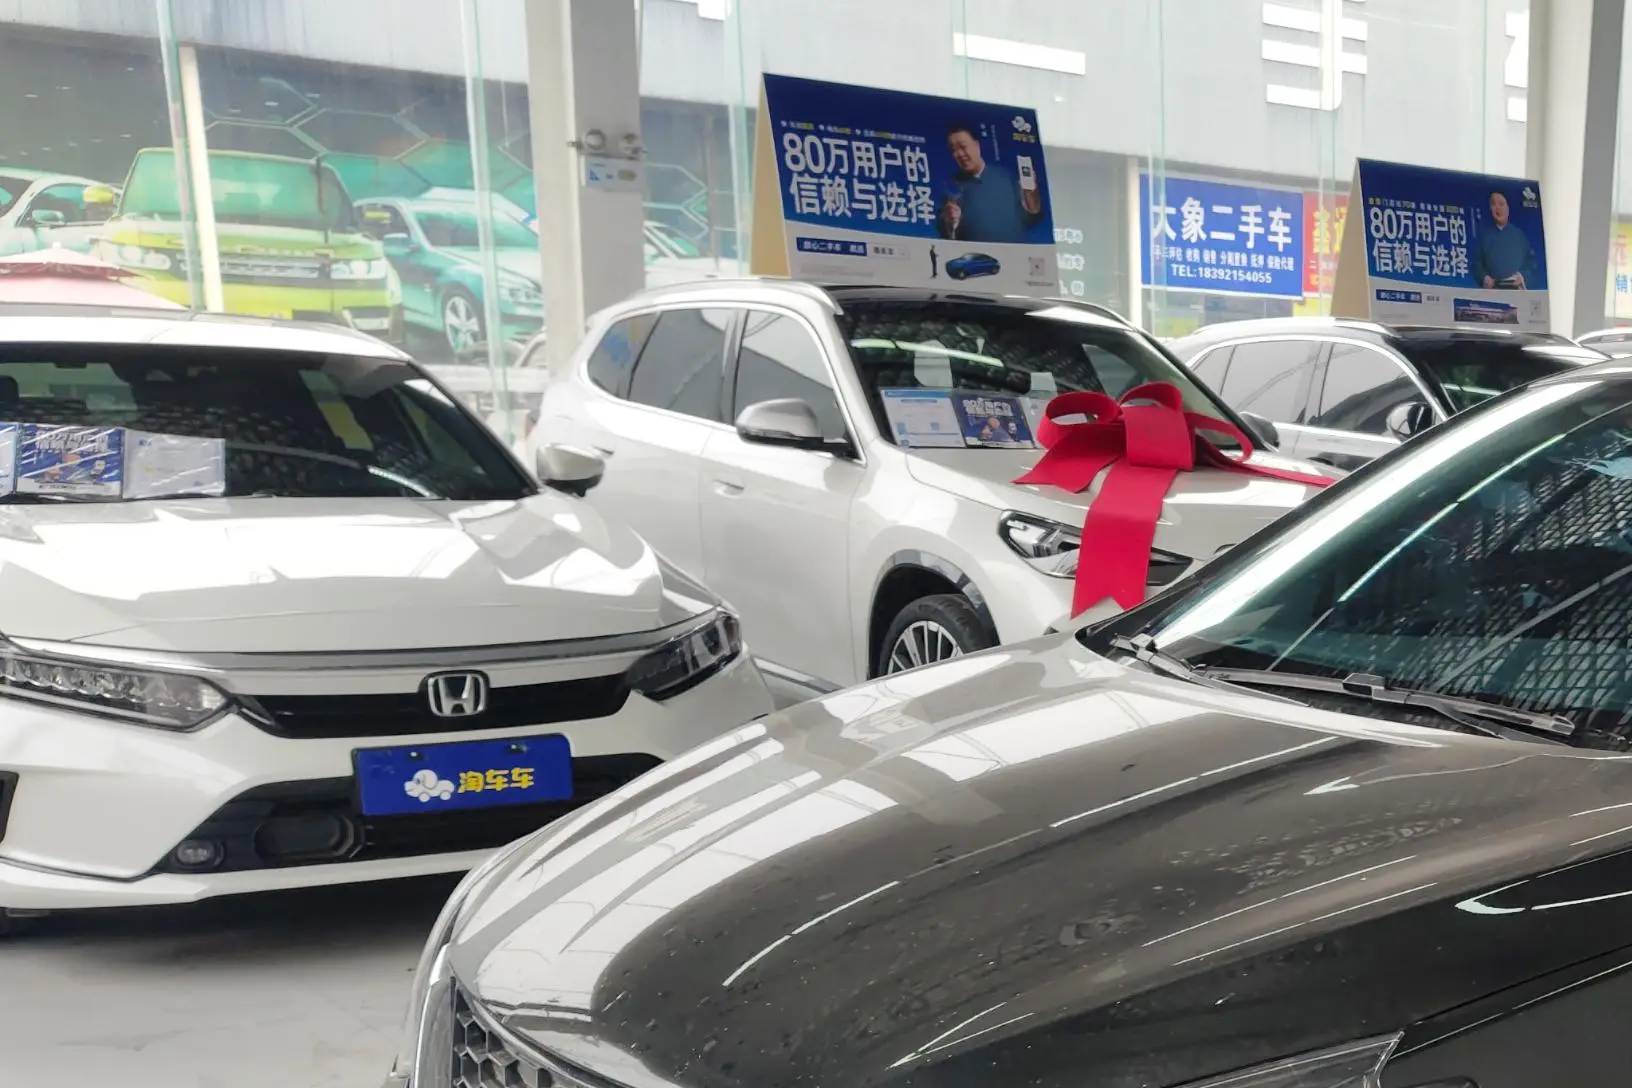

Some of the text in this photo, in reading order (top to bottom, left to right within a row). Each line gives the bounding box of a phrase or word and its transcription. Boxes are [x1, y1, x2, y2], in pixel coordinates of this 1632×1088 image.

[783, 132, 930, 183] 80万用户的
[790, 173, 936, 226] 信赖与选择
[1152, 197, 1292, 252] 大象二手车
[1370, 207, 1467, 245] 80万用户的
[1372, 238, 1469, 278] 信赖与选择
[457, 767, 535, 793] 淘车车
